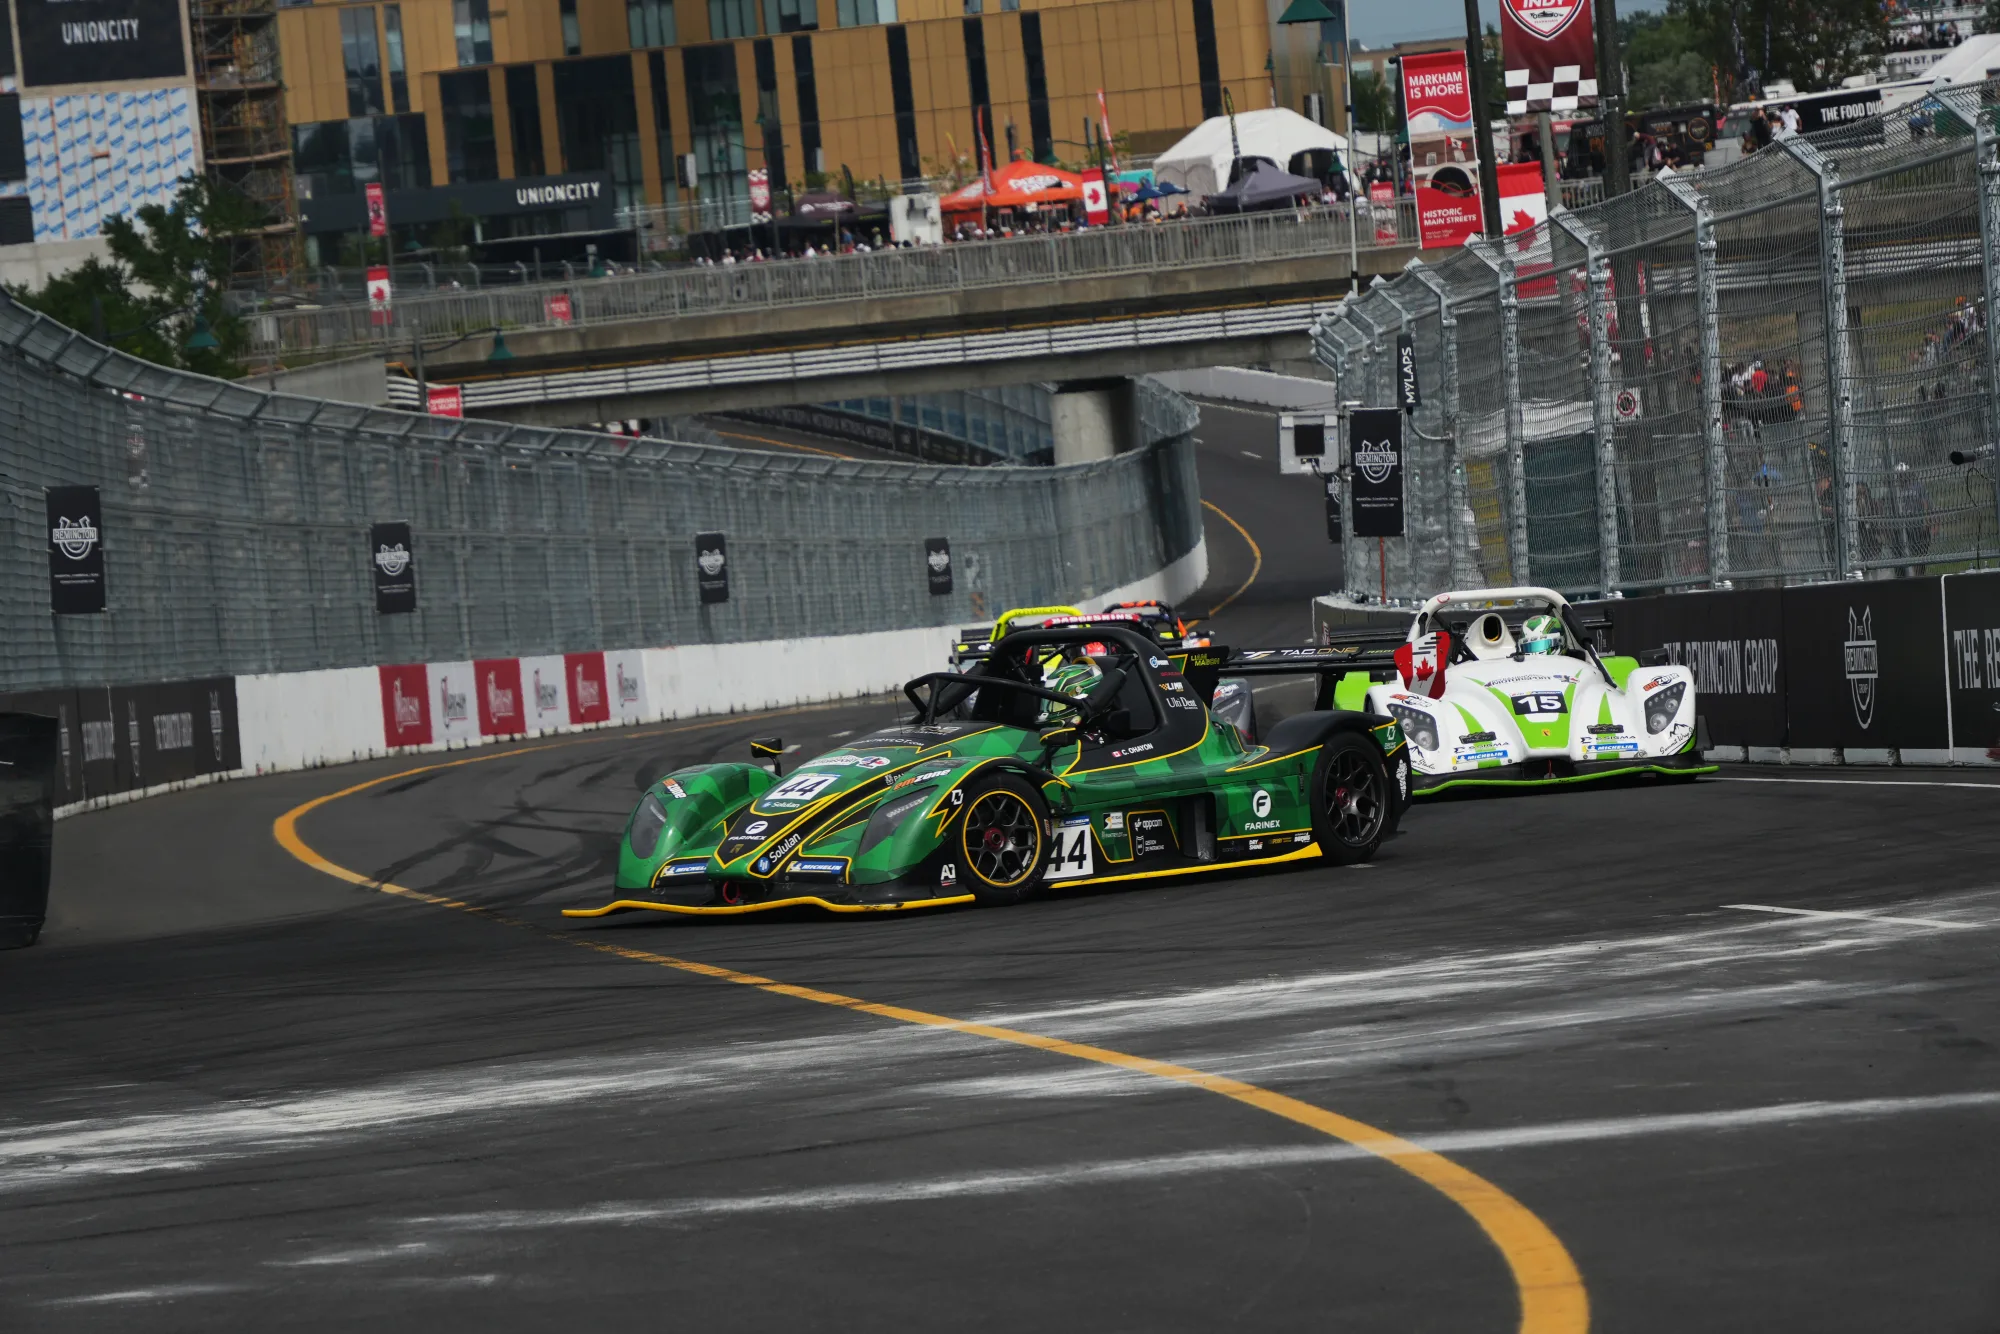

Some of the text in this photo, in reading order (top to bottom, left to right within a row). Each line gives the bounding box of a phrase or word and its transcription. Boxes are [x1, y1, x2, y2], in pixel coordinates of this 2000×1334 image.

[62, 19, 139, 45] UNIONCITY
[1409, 71, 1462, 86] MARKHAM
[1410, 83, 1463, 99] IS MORE
[1820, 106, 1839, 124] THE
[1840, 101, 1865, 119] FOOD
[516, 182, 600, 206] UNIONCITY
[1423, 207, 1462, 219] HISTORIC
[1424, 213, 1477, 227] MAIN STREETS
[1402, 347, 1416, 404] MYLAPS
[1358, 452, 1395, 463] REMINGTON
[54, 530, 95, 540] REMINGTON
[1281, 646, 1359, 656] TAG ONE
[1845, 646, 1876, 672] REMINGTON
[1954, 628, 1981, 690] THE
[1685, 639, 1741, 694] REMINGTON
[1744, 638, 1778, 694] GROUP
[1517, 695, 1562, 712] 15
[1130, 743, 1154, 755] OHAYON
[1597, 742, 1634, 750] MICHELIN
[1467, 752, 1503, 760] MICHELIN
[777, 778, 828, 797] 44
[893, 769, 951, 791] emzone
[1142, 819, 1163, 830] appcom
[1244, 820, 1281, 831] FARINEX
[769, 833, 801, 863] Solulan
[1049, 829, 1087, 872] 44
[801, 863, 842, 871] MICHELIN
